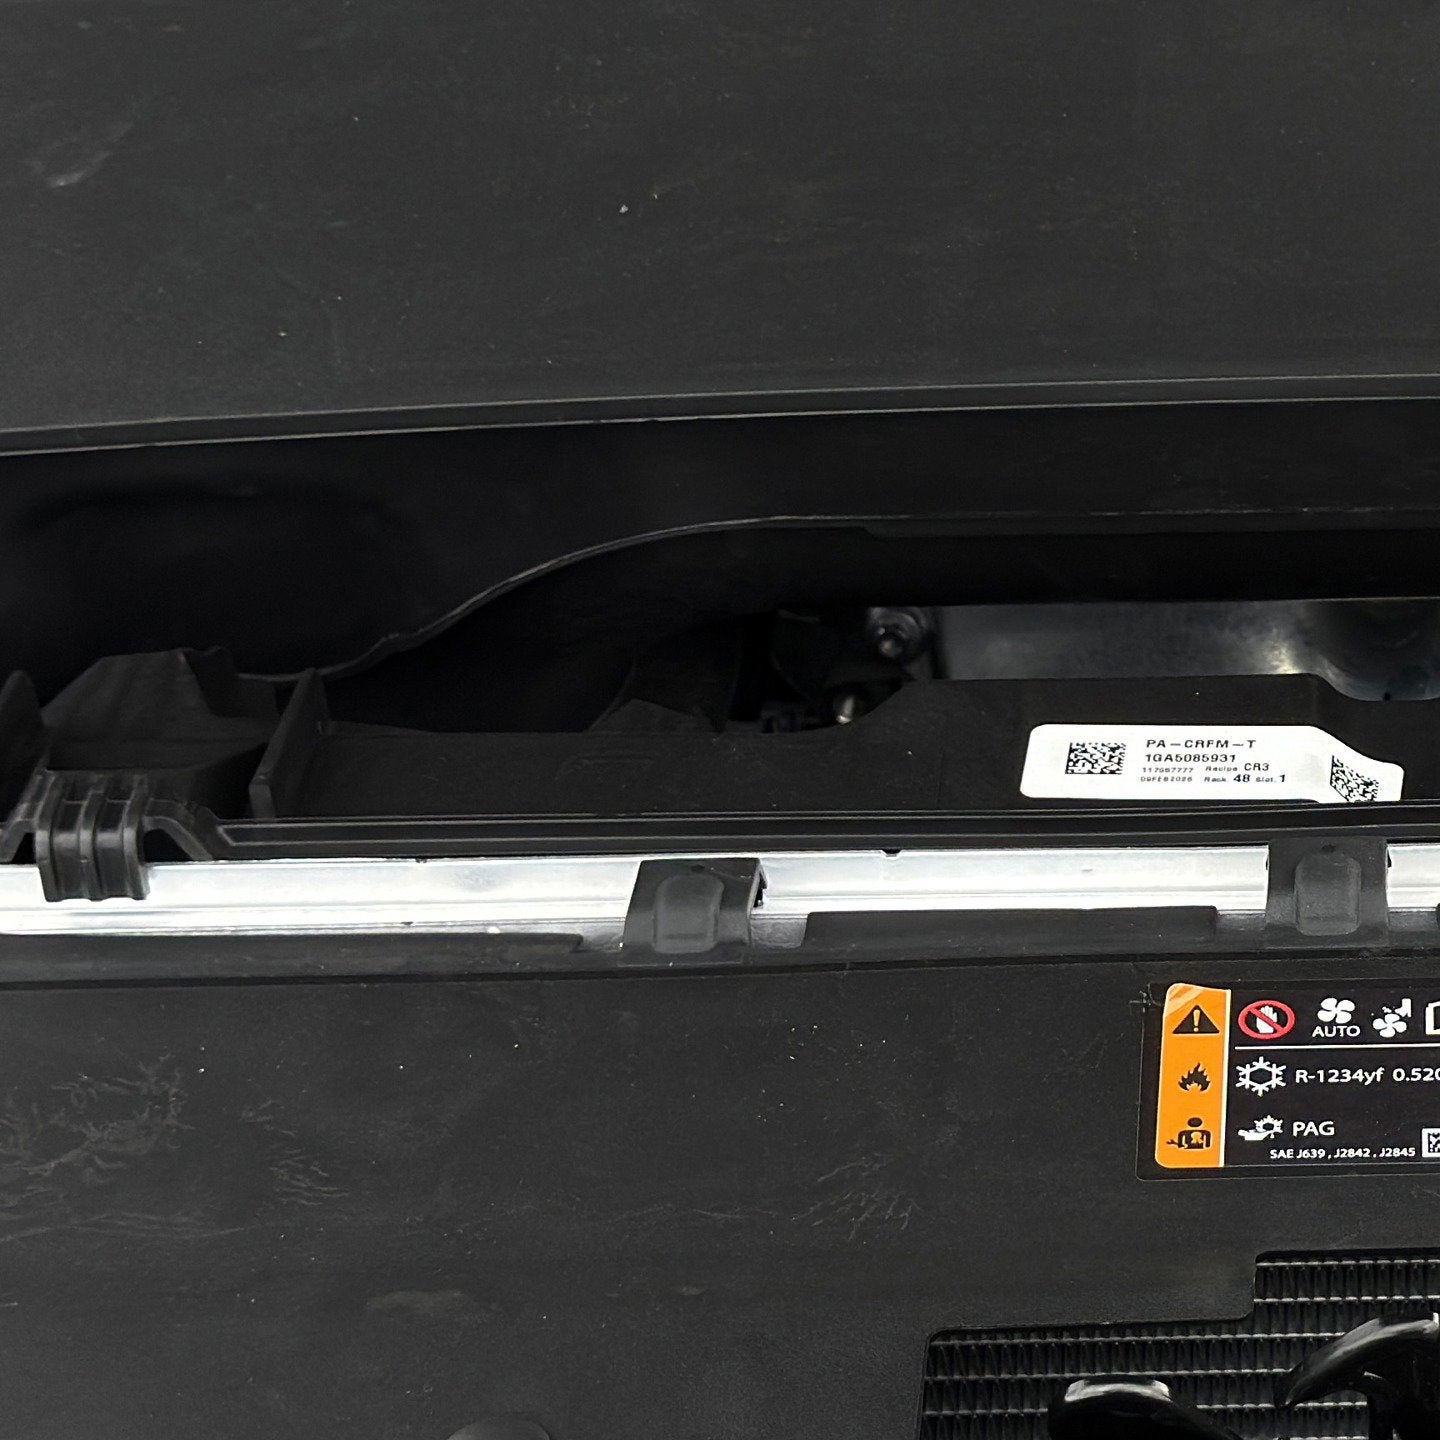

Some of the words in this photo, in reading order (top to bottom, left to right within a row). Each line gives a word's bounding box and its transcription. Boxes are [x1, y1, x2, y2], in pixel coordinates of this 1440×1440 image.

[1145, 753, 1236, 763] 1GA5085931
[1244, 762, 1270, 772] CR3
[1233, 773, 1251, 783] 48
[1279, 773, 1286, 783] 1
[1312, 1024, 1360, 1038] AUTO
[1295, 1068, 1383, 1087] R-1234yf
[1292, 1121, 1335, 1137] PAG
[1270, 1149, 1294, 1159] SAE
[1378, 1146, 1417, 1159] J2845
